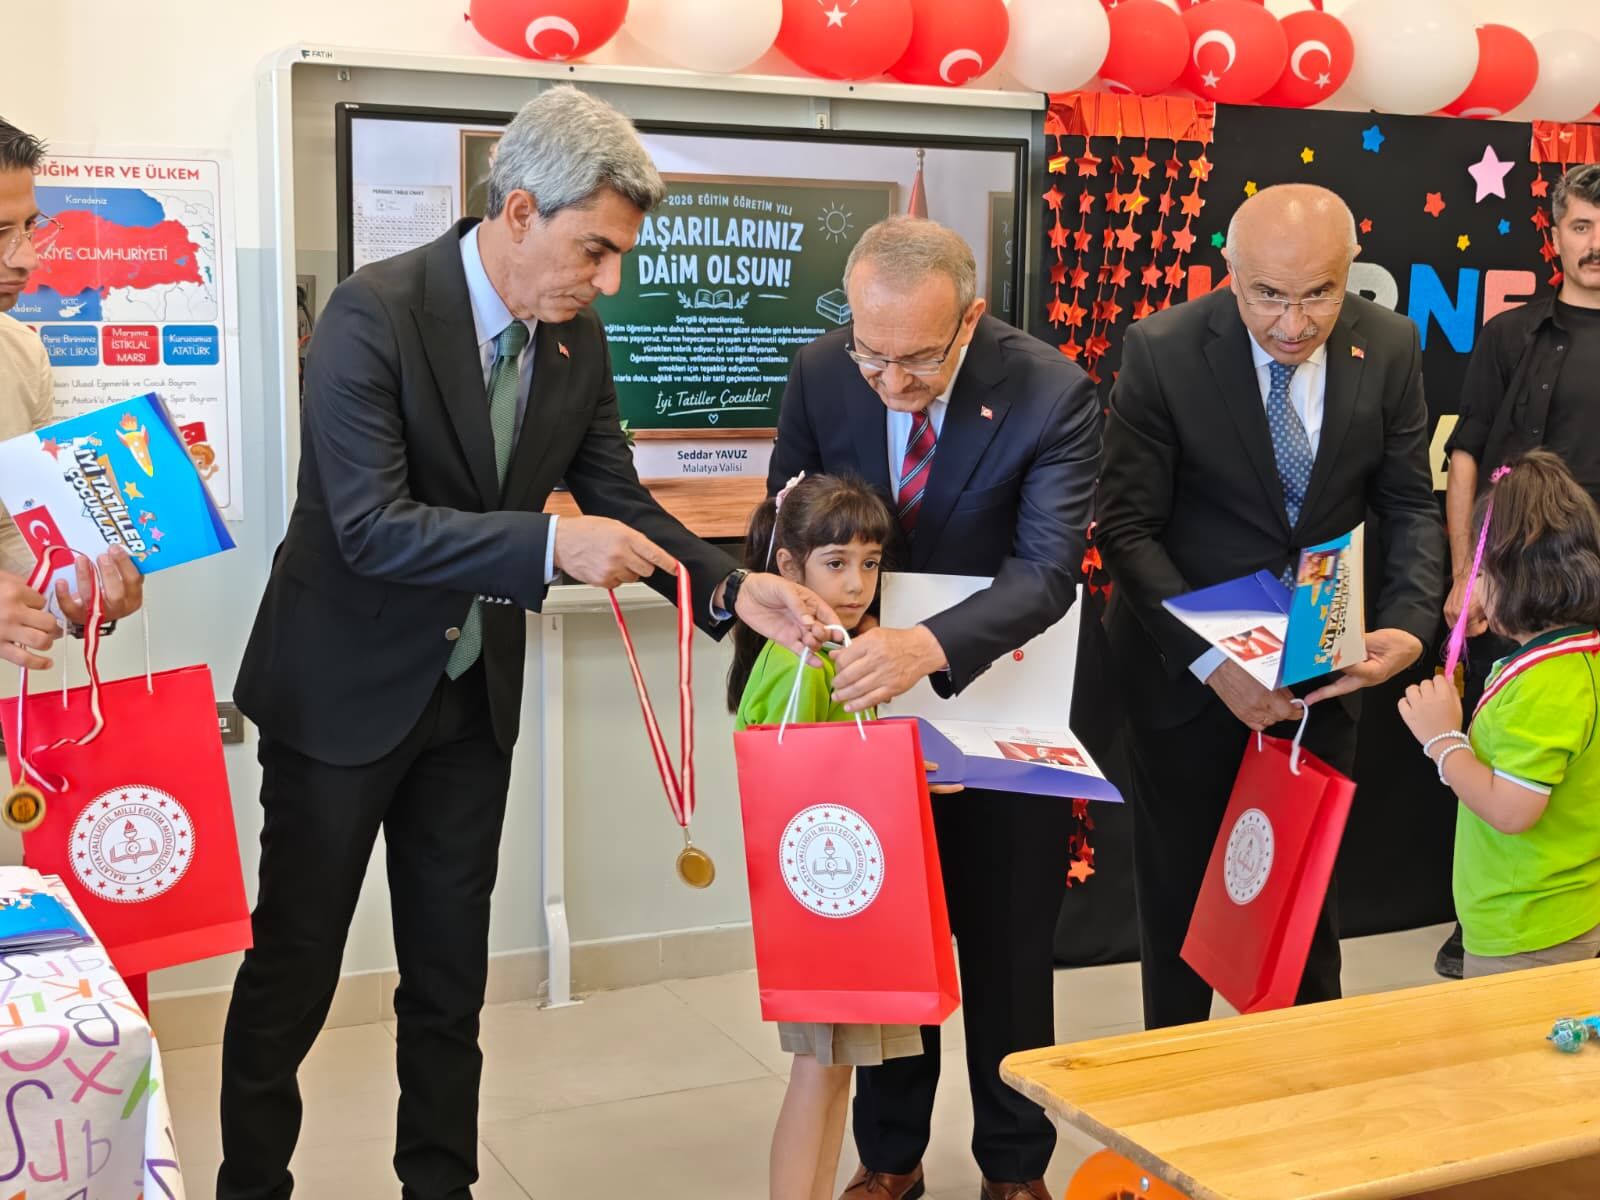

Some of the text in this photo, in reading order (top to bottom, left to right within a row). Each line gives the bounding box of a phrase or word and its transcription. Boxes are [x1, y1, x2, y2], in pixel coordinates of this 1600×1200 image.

[84, 165, 115, 178] YER
[120, 166, 141, 179] VE
[146, 164, 200, 181] ÜLKEM
[65, 194, 108, 205] Karadeniz
[698, 193, 729, 206] EĞİTİM
[733, 195, 773, 211] ÖĞRETİM
[776, 203, 793, 216] YILI
[76, 245, 169, 261] CUMHURİYETİ
[706, 255, 792, 288] OLSUN!
[112, 328, 149, 339] Marşımız
[669, 325, 684, 333] daha
[733, 327, 750, 336] güzel
[63, 334, 98, 344] Birimimiz
[111, 339, 150, 350] İSTİKLAL
[168, 334, 212, 344] Kurucumuz
[70, 345, 98, 357] LİRASI
[172, 344, 211, 356] ATATÜRK
[673, 345, 692, 353] tebrik
[687, 364, 699, 374] için
[71, 379, 94, 388] Ulusal
[96, 379, 129, 391] Egemenlik
[655, 387, 771, 415] İyi Tatiller Çocuklar!
[677, 449, 748, 461] Seddar YAVUZ
[682, 462, 743, 475] Malatya Valisi
[64, 466, 122, 545] ÇOCUKLAR
[74, 448, 147, 554] İYİ TATİLLER
[94, 856, 128, 882] MALATYA
[113, 805, 137, 818] MİLLİ
[138, 806, 165, 827] EĞİTİM
[799, 864, 825, 895] MALATYA
